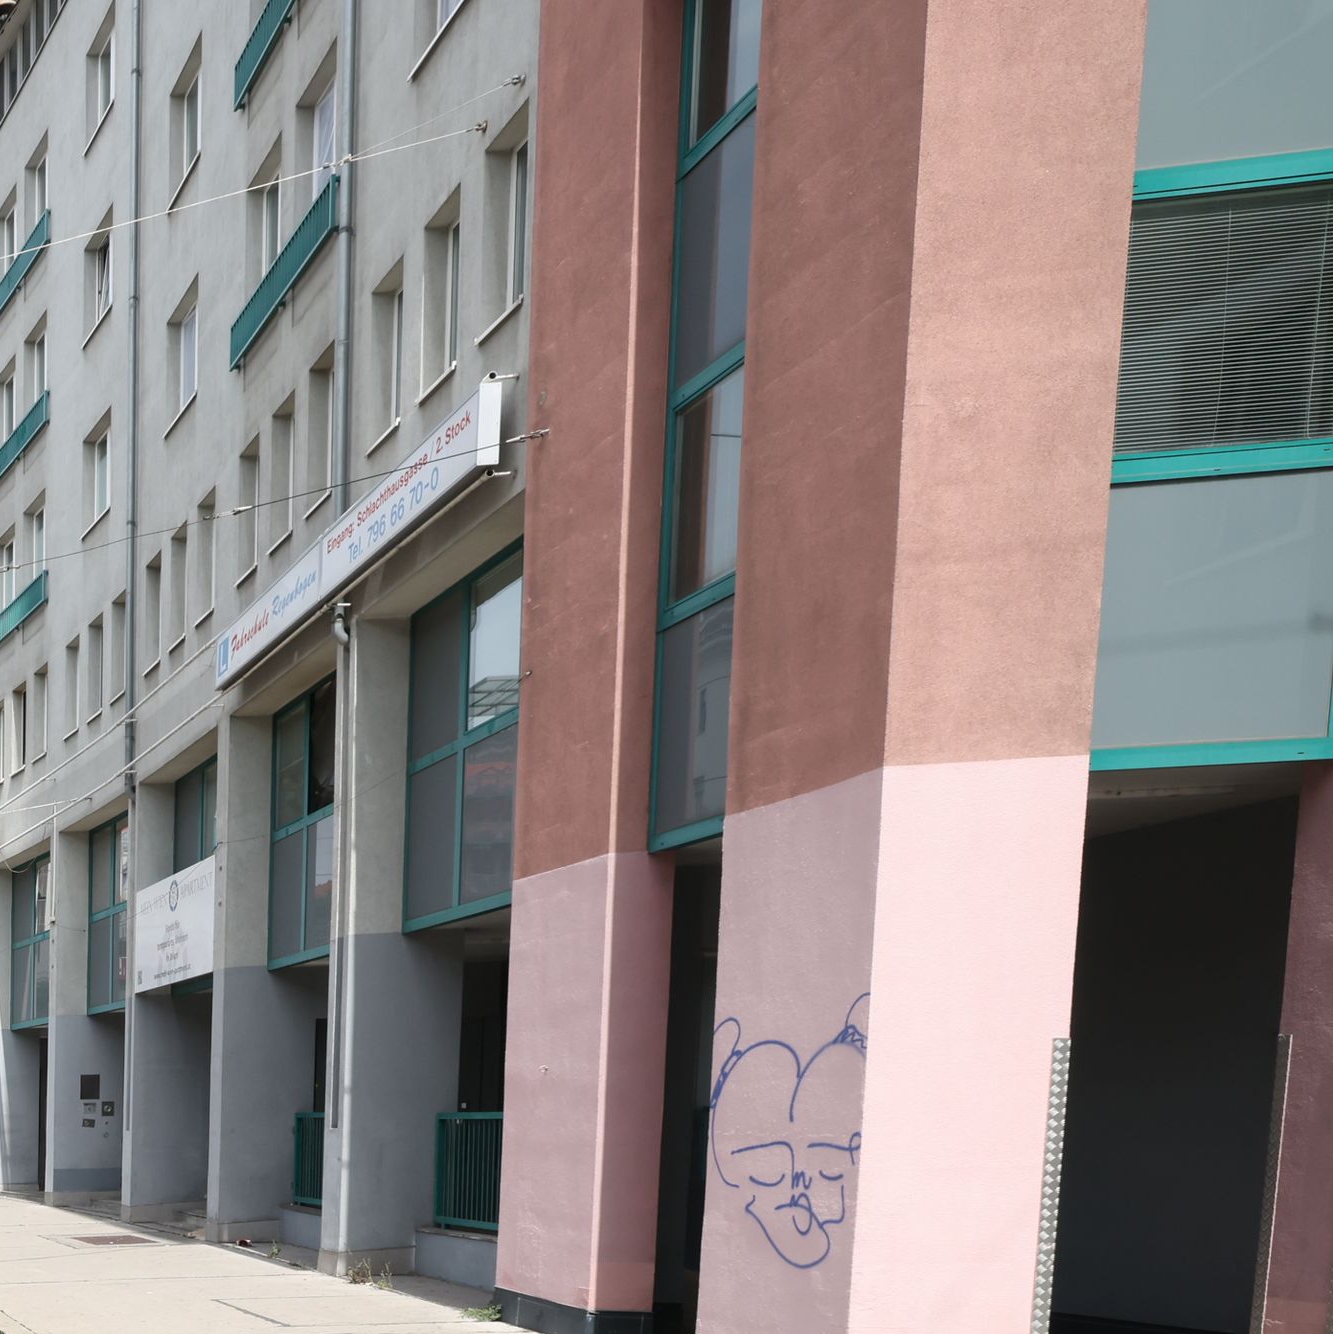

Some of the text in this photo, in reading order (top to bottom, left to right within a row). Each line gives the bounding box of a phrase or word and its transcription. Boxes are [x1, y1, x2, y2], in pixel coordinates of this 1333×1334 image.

[326, 523, 354, 553] Eingang:
[357, 453, 429, 527] Schlachthausgasse
[445, 411, 471, 445] Stock
[348, 466, 439, 563] Tel. 796 66 70-0
[230, 608, 270, 661] Fahrschule
[272, 570, 316, 617] Regenbogen
[179, 871, 214, 898] APARTMENT
